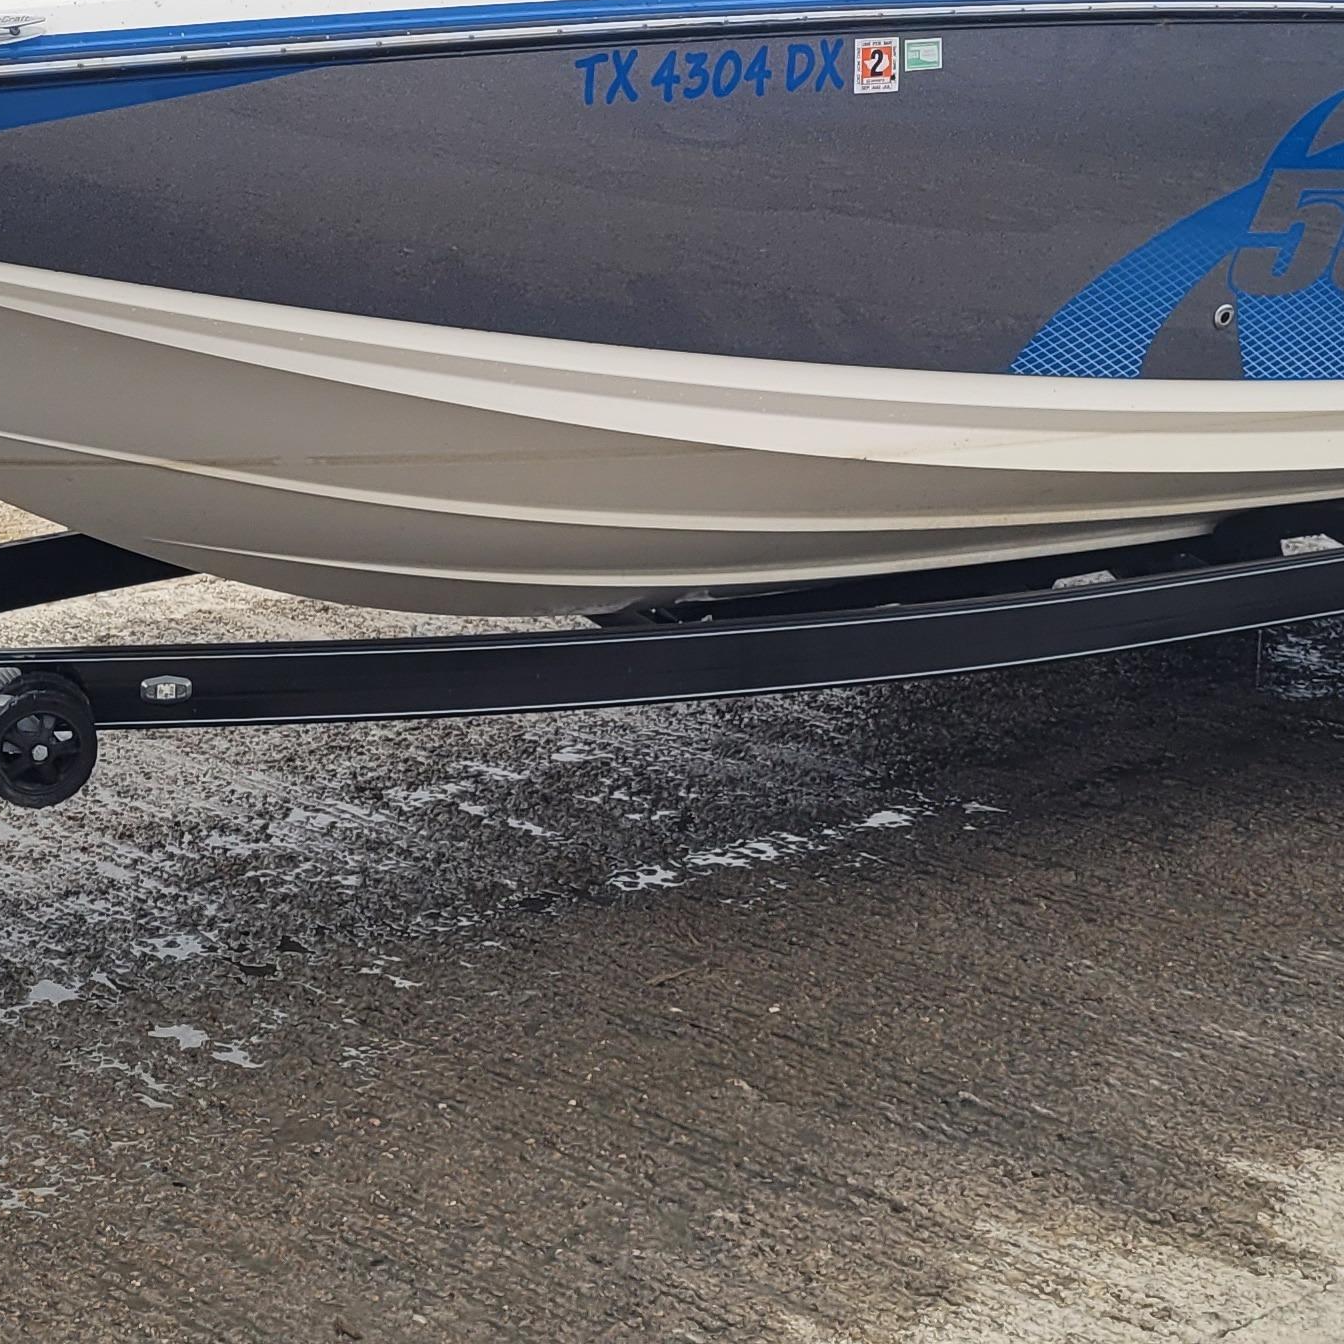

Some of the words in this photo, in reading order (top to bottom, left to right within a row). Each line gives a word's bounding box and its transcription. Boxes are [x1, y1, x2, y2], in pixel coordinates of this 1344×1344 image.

[575, 49, 639, 105] TX
[651, 45, 772, 103] 4304
[785, 38, 845, 93] DX
[870, 49, 884, 77] 2
